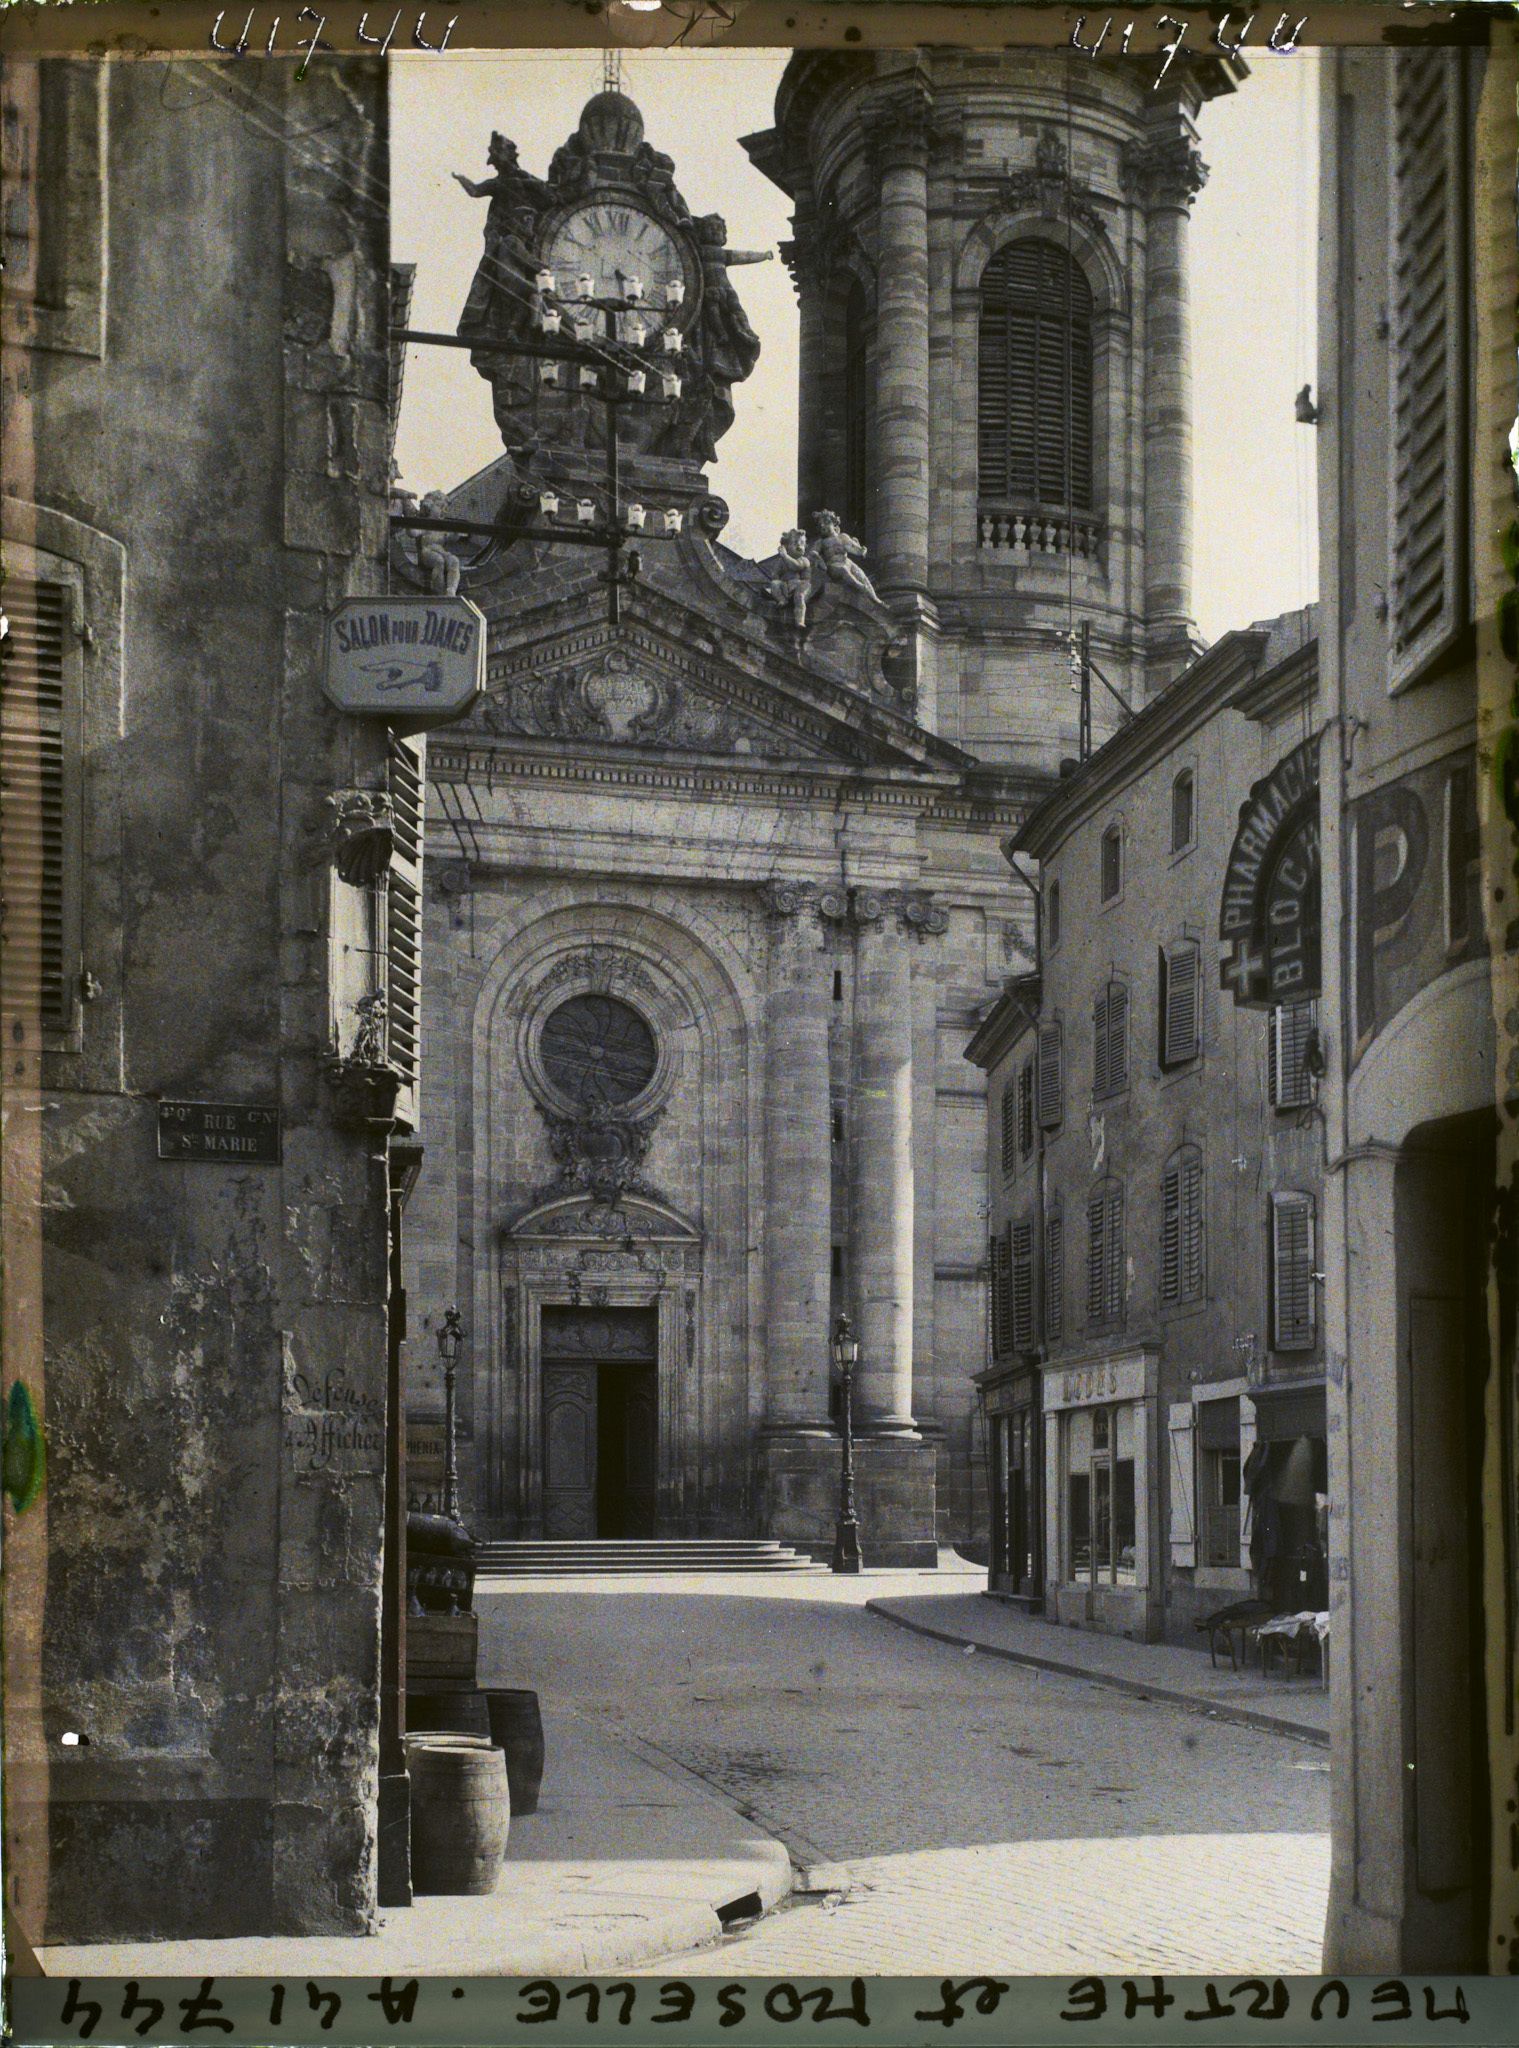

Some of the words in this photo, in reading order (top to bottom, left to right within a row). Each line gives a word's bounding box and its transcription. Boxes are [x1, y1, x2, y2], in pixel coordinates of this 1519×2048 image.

[334, 613, 391, 653] SALON
[392, 619, 419, 644] POUR
[420, 609, 473, 655] DAMES
[204, 1114, 236, 1130] RUE
[204, 1134, 257, 1153] MARIE
